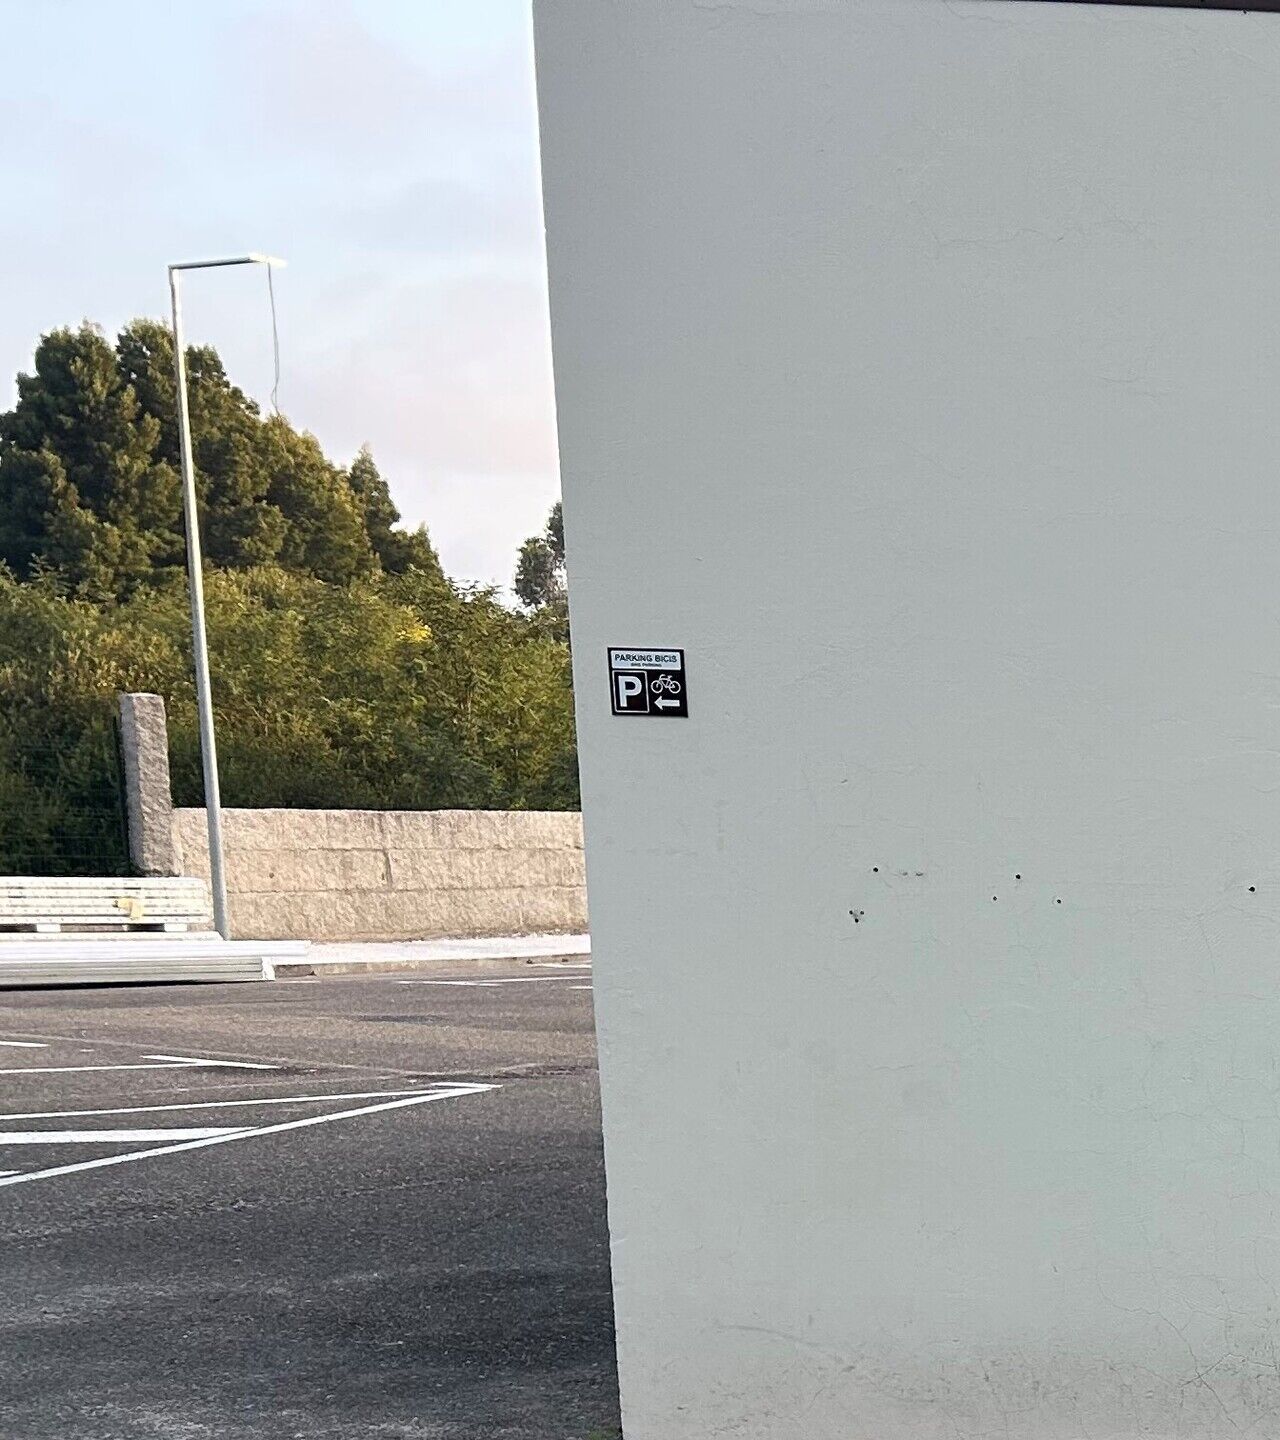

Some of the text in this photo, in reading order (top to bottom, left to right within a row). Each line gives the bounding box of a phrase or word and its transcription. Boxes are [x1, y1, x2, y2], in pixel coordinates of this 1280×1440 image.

[615, 654, 677, 663] PARKING BICIS
[618, 676, 642, 707] P
